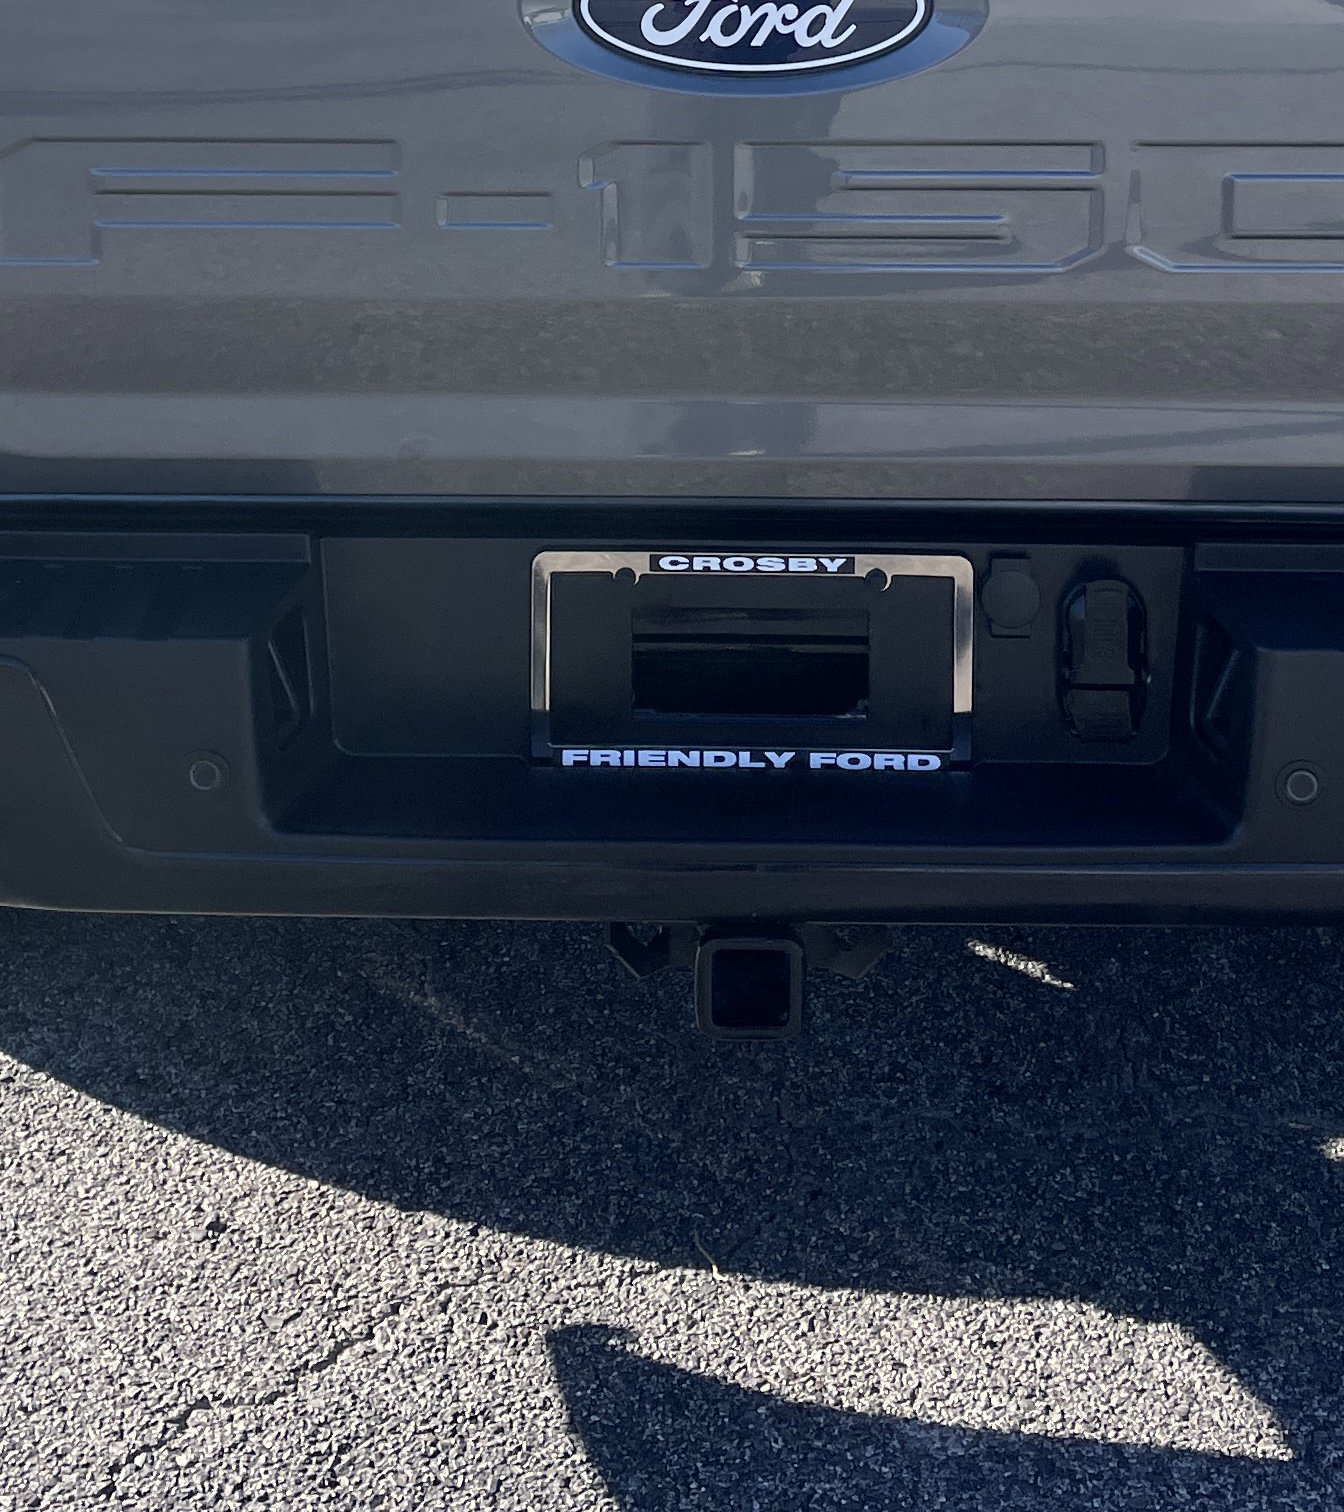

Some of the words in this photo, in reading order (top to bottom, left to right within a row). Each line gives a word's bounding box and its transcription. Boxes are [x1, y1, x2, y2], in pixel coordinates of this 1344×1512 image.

[658, 555, 848, 572] CROSBY
[561, 749, 796, 769] FRIENDLY
[809, 752, 942, 771] FORD
